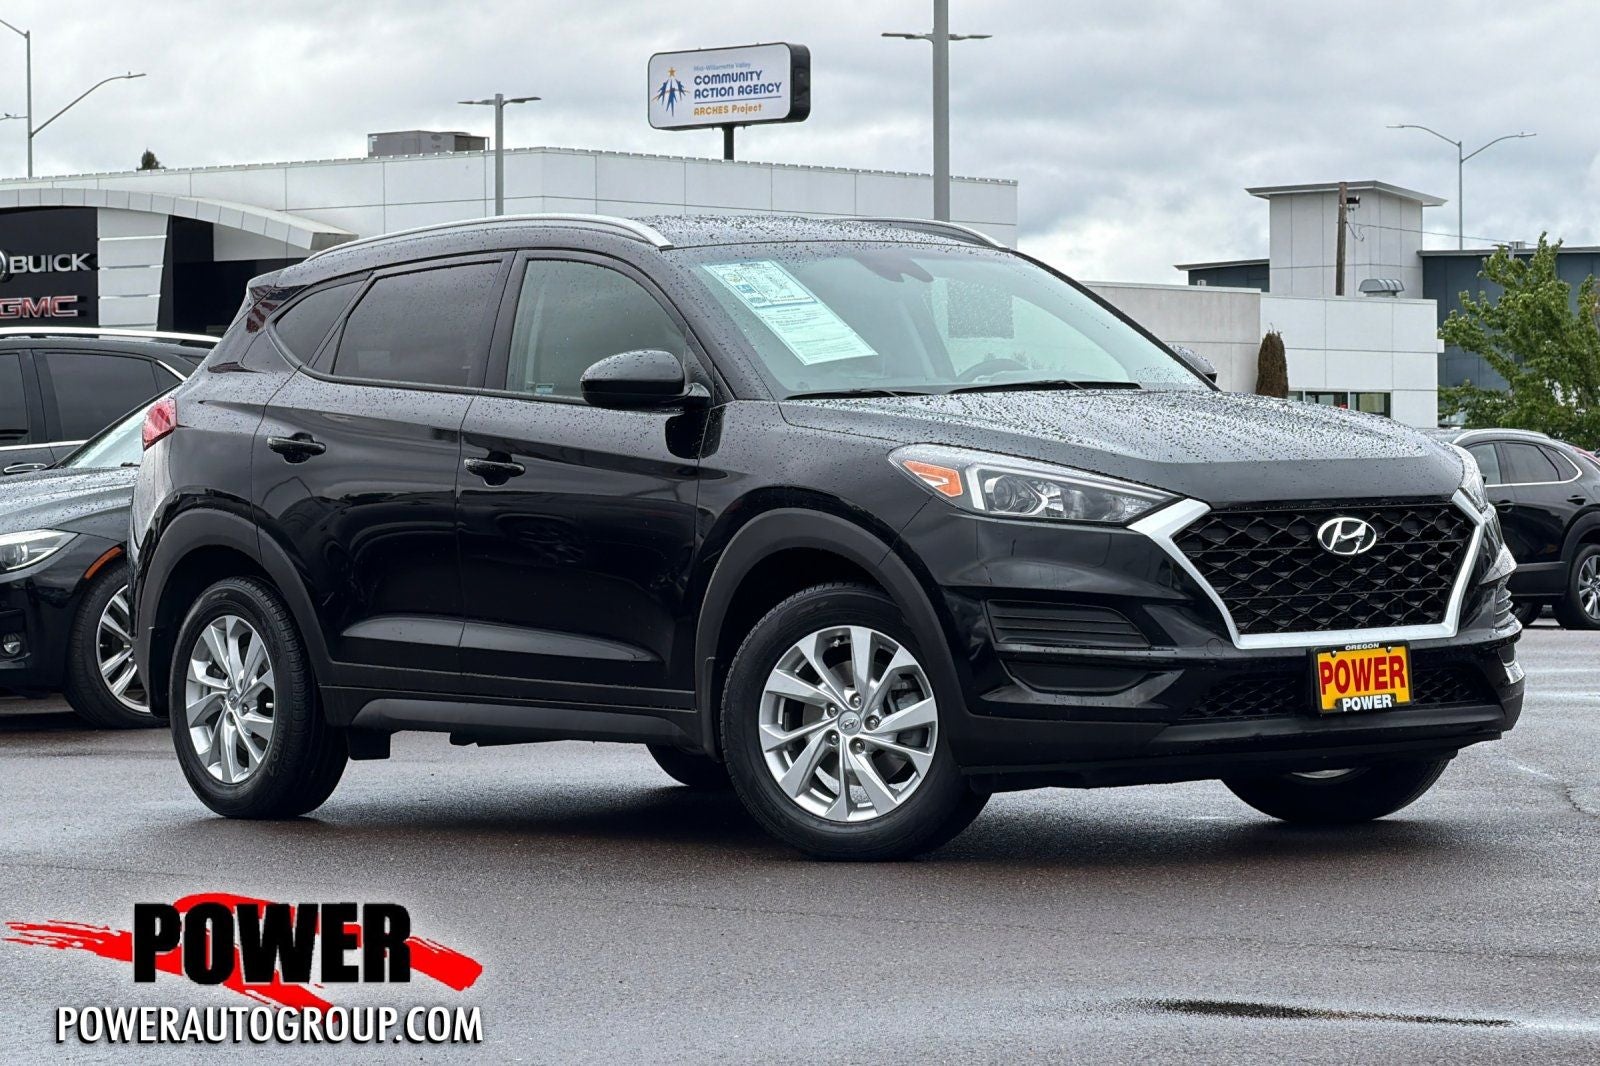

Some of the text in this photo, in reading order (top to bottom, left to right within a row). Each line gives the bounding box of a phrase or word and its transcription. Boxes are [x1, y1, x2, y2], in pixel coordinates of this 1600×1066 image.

[694, 70, 763, 86] COMMUNITY
[694, 82, 782, 99] ACTION AGENCY
[694, 103, 762, 116] ARCHES Project
[9, 253, 91, 274] BUICK
[0, 295, 78, 318] GMC
[1345, 643, 1379, 651] OREGON
[1319, 655, 1406, 695] POWER
[1342, 694, 1392, 712] POWER
